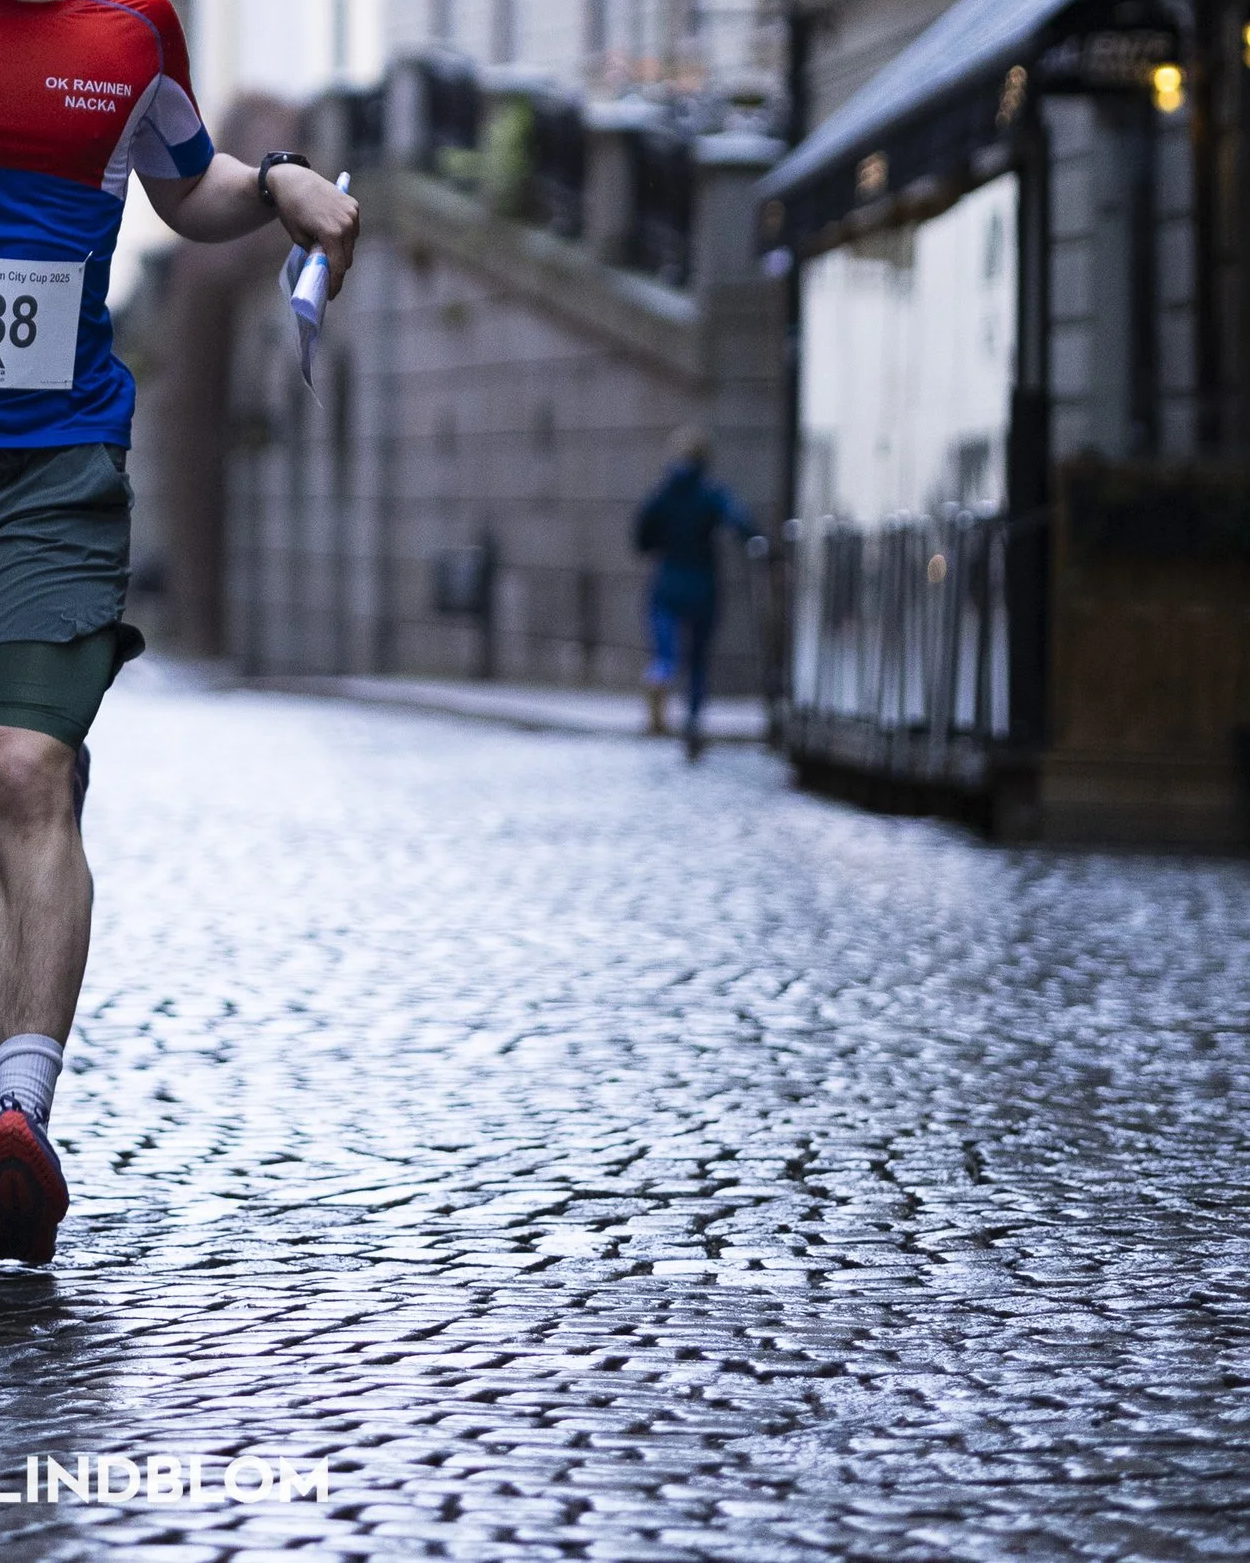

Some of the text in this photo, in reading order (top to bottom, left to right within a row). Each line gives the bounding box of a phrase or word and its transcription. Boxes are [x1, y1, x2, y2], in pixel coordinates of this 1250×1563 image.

[45, 76, 132, 97] OK RAVINEN
[65, 95, 116, 112] NACKA
[8, 270, 27, 284] City
[29, 273, 48, 284] Cup
[50, 273, 71, 283] 2025
